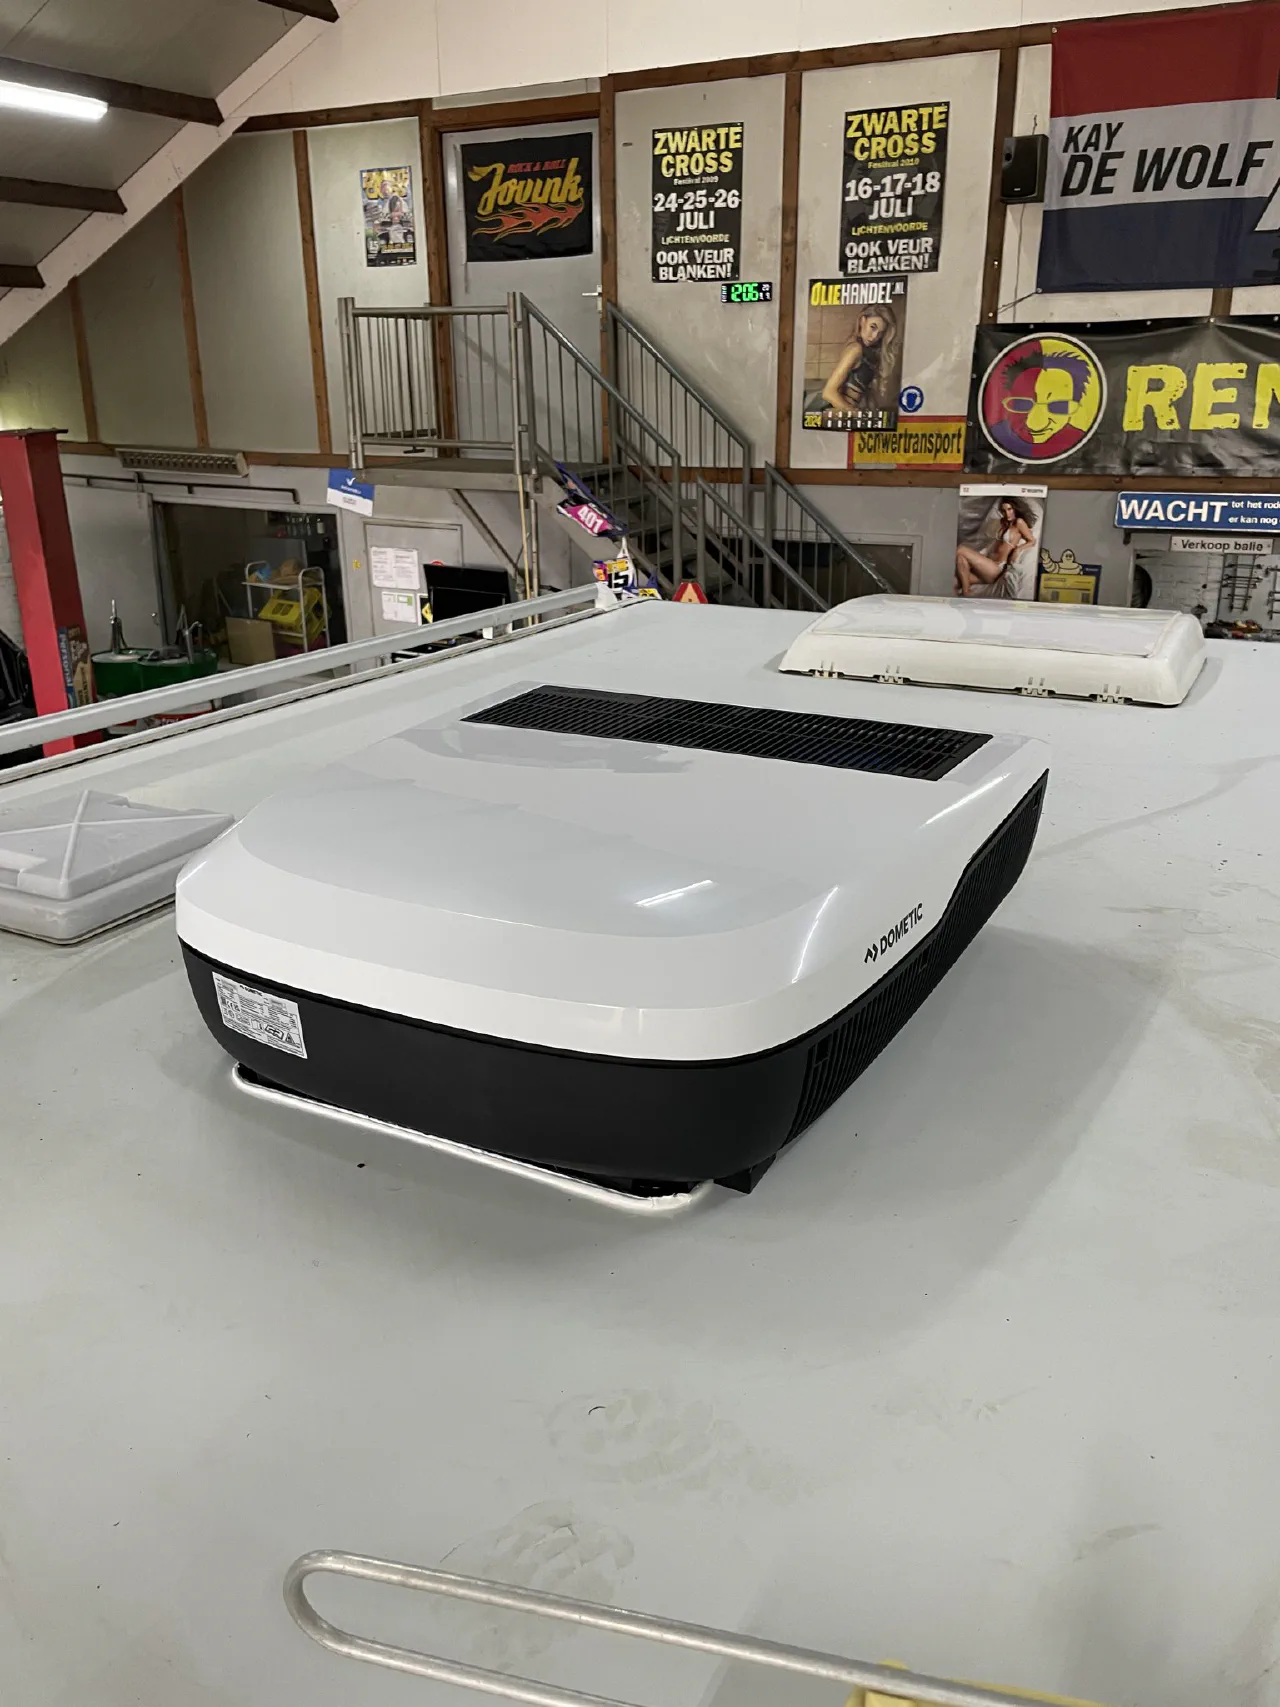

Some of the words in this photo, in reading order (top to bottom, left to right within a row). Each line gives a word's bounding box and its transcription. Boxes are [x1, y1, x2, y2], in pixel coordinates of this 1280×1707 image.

[846, 105, 948, 138] ZWARTE
[653, 126, 743, 155] ZWARTE
[854, 132, 937, 160] CROSS
[1062, 121, 1124, 153] KAY
[661, 151, 733, 177] CROSS
[1060, 151, 1126, 197] DE
[1132, 140, 1274, 193] WOLF
[845, 171, 941, 201] 16-17-18
[653, 189, 740, 212] 24-25-26
[868, 197, 913, 220] JULI
[676, 210, 715, 231] JULI
[852, 222, 928, 236] LICHTENVOORDE
[661, 234, 730, 245] LICHTENVOORDE
[845, 241, 881, 258] OOK
[887, 237, 933, 254] VEUR
[656, 249, 689, 265] OOK
[694, 248, 735, 264] VEUR
[847, 254, 929, 274] BLANKEN!
[659, 263, 732, 281] BLANKEN!
[1119, 499, 1228, 523] WACHT
[1232, 501, 1244, 509] tot
[1247, 501, 1262, 509] het
[1264, 501, 1280, 509] rod
[577, 506, 604, 534] 401
[1240, 515, 1258, 523] kan
[1260, 517, 1278, 526] nog
[1181, 540, 1230, 551] Verkoop
[1234, 540, 1263, 551] balie
[880, 902, 923, 956] DOMETIC
